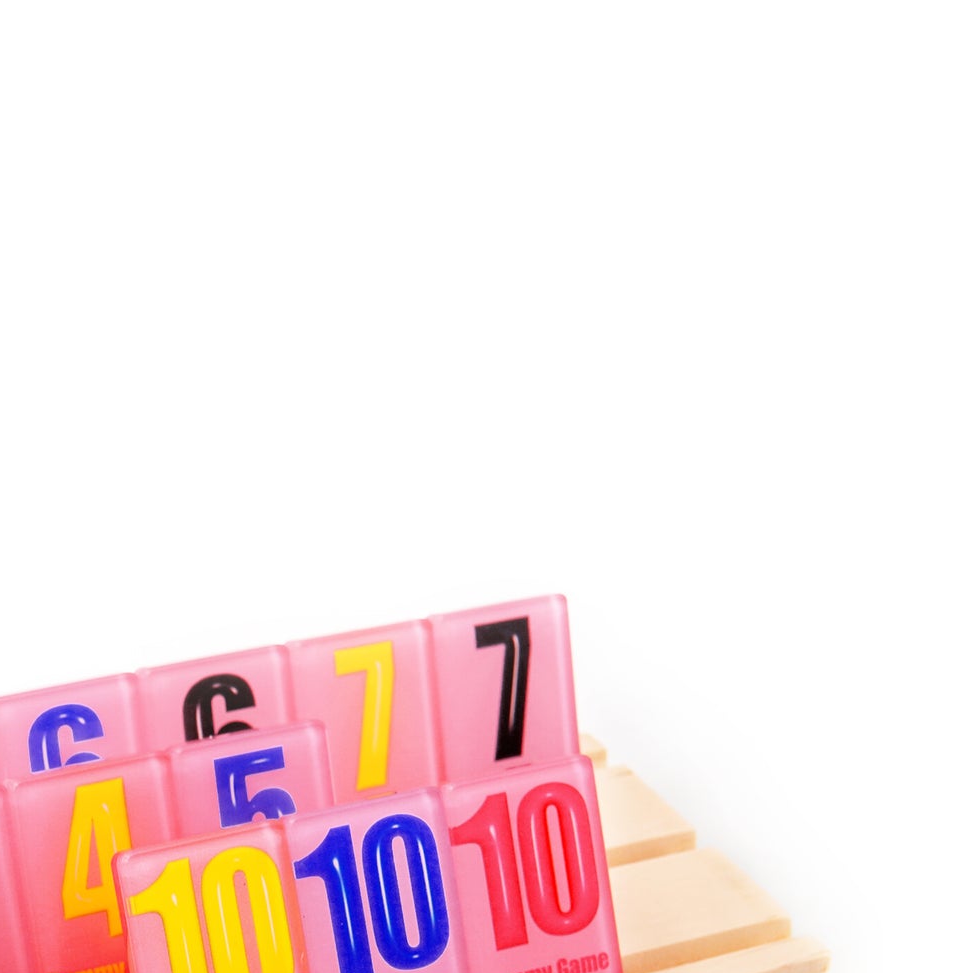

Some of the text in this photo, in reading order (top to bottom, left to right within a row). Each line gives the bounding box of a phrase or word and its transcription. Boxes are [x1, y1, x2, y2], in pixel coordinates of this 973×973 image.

[335, 641, 394, 791] 7
[475, 616, 530, 761] 7
[62, 777, 133, 938] 4
[449, 781, 600, 951] 10
